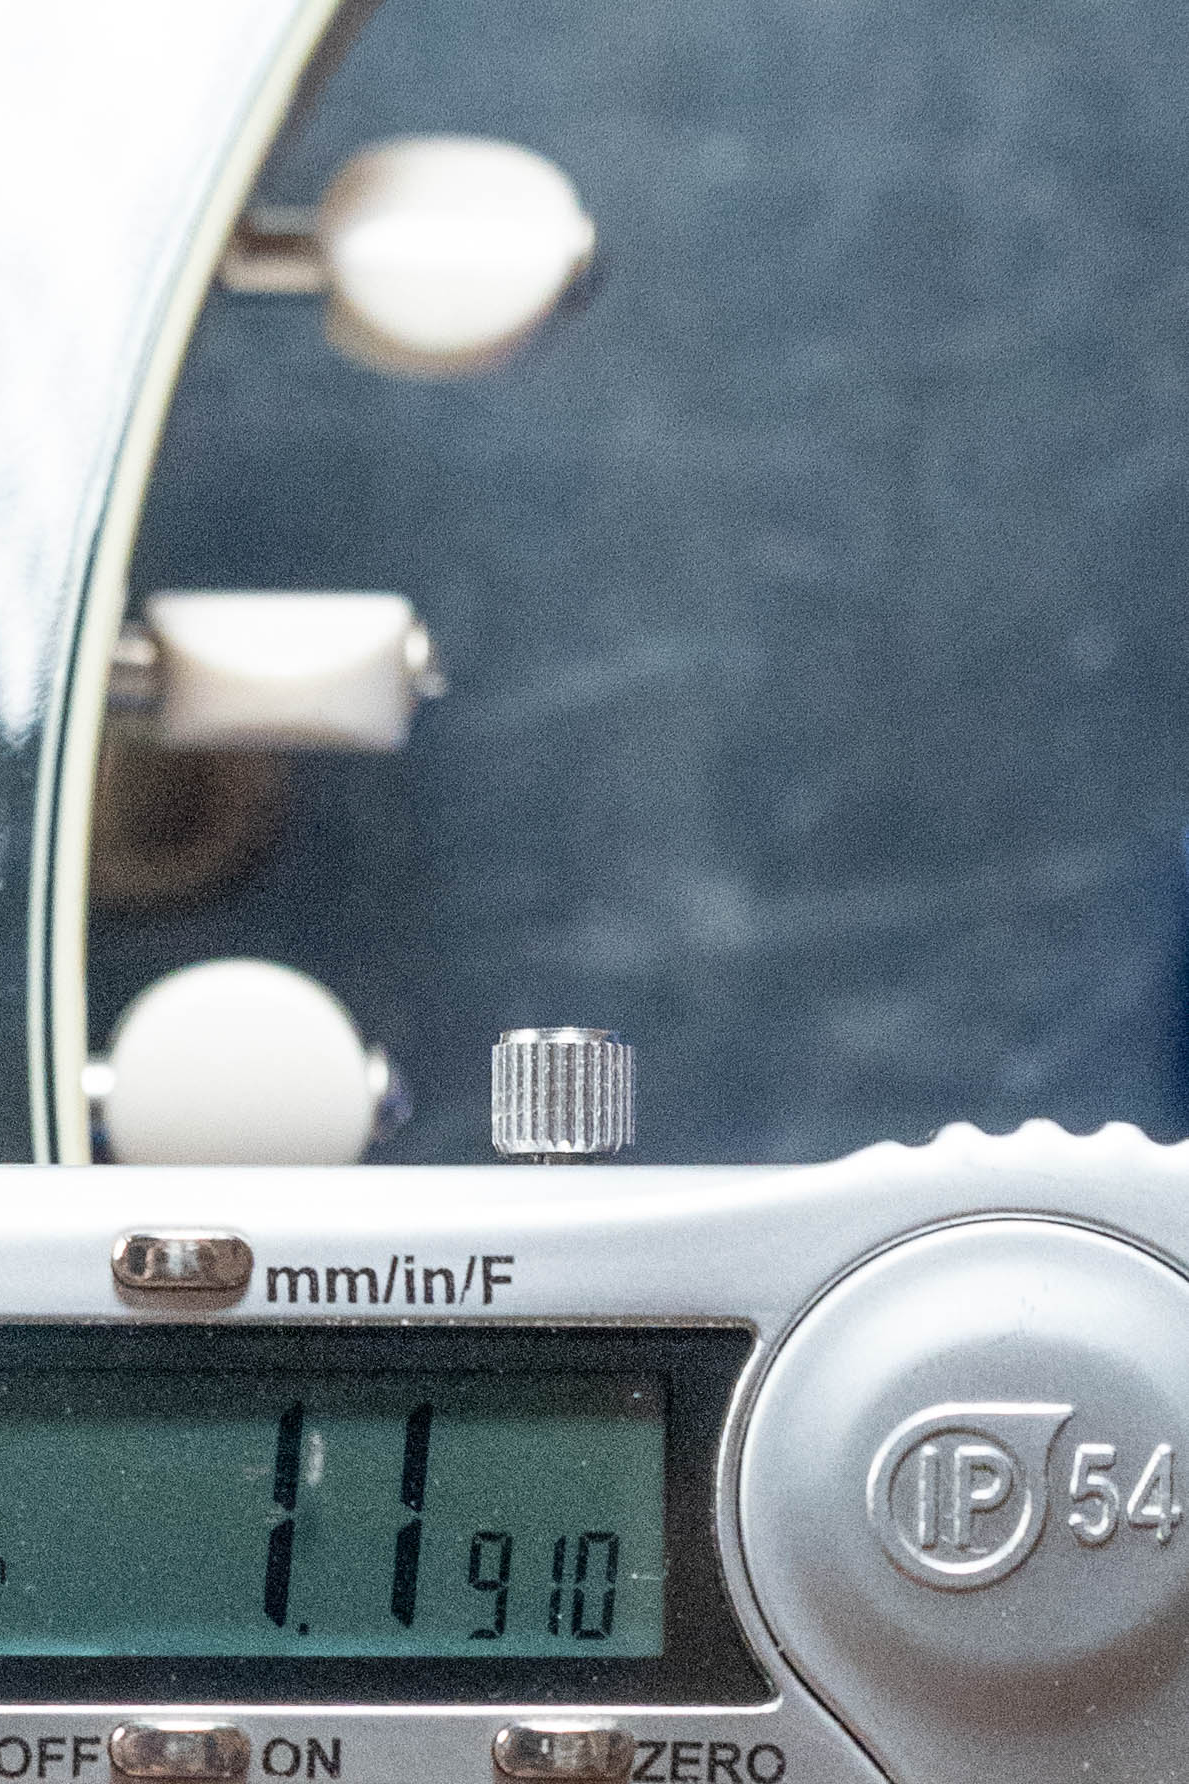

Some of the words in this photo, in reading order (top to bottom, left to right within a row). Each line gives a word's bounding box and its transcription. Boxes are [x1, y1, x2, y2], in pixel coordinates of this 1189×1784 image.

[266, 1255, 516, 1306] mm/in/F
[918, 1443, 1016, 1551] IP
[1067, 1442, 1183, 1549] 54
[261, 1736, 343, 1780] ON
